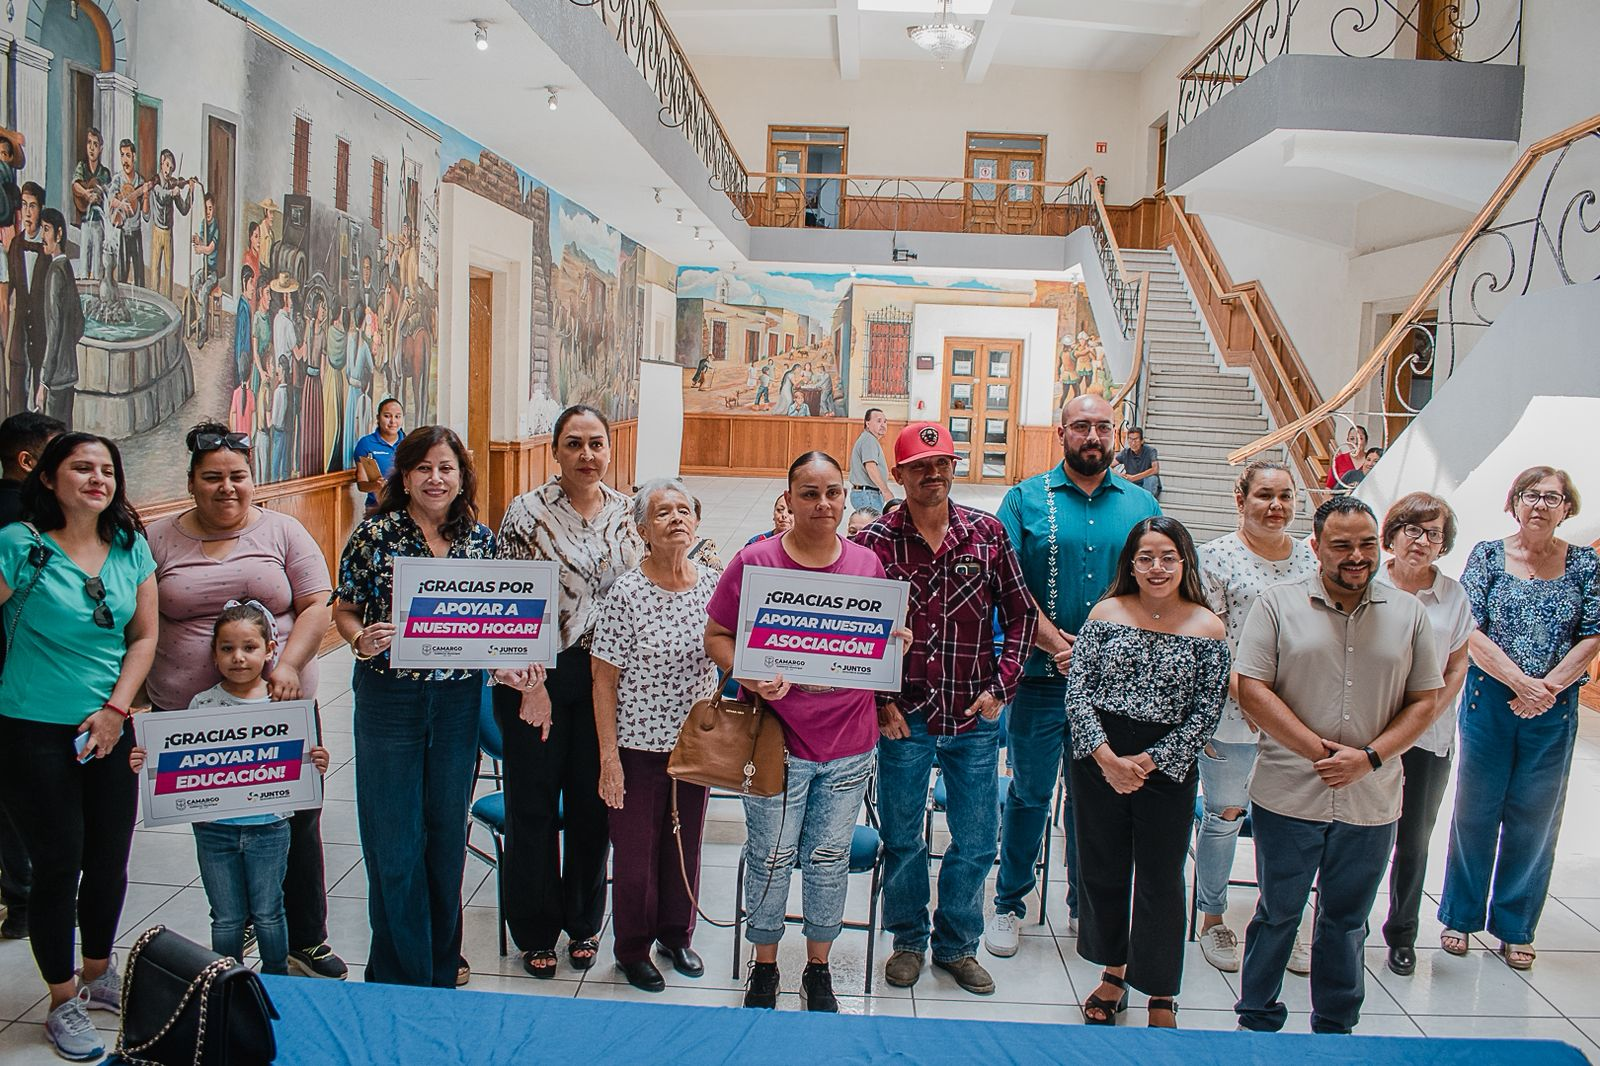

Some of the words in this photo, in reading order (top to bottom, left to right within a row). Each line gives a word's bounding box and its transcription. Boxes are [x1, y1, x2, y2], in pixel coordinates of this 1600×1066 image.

[417, 580, 495, 593] ¡GRACIAS
[498, 581, 534, 594] POR
[765, 590, 844, 609] ¡GRACIAS
[846, 598, 882, 613] POR
[433, 602, 503, 616] APOYAR
[503, 603, 518, 616] A
[412, 622, 480, 634] NUESTRO
[481, 623, 539, 635] HOGAR!
[759, 613, 818, 629] APOYAR
[820, 618, 884, 635] NUESTRA
[764, 633, 875, 656] ASOCIACIÓN!
[774, 658, 806, 667] CAMARGO
[842, 665, 872, 673] JUNTOS
[164, 727, 247, 749] ¡GRACIAS
[251, 723, 289, 739] POR
[179, 752, 254, 769] APOYAR
[257, 746, 279, 761] MI
[176, 765, 287, 789] EDUCACIÓN!
[186, 796, 220, 805] CAMARGO
[259, 789, 290, 799] JUNTOS
